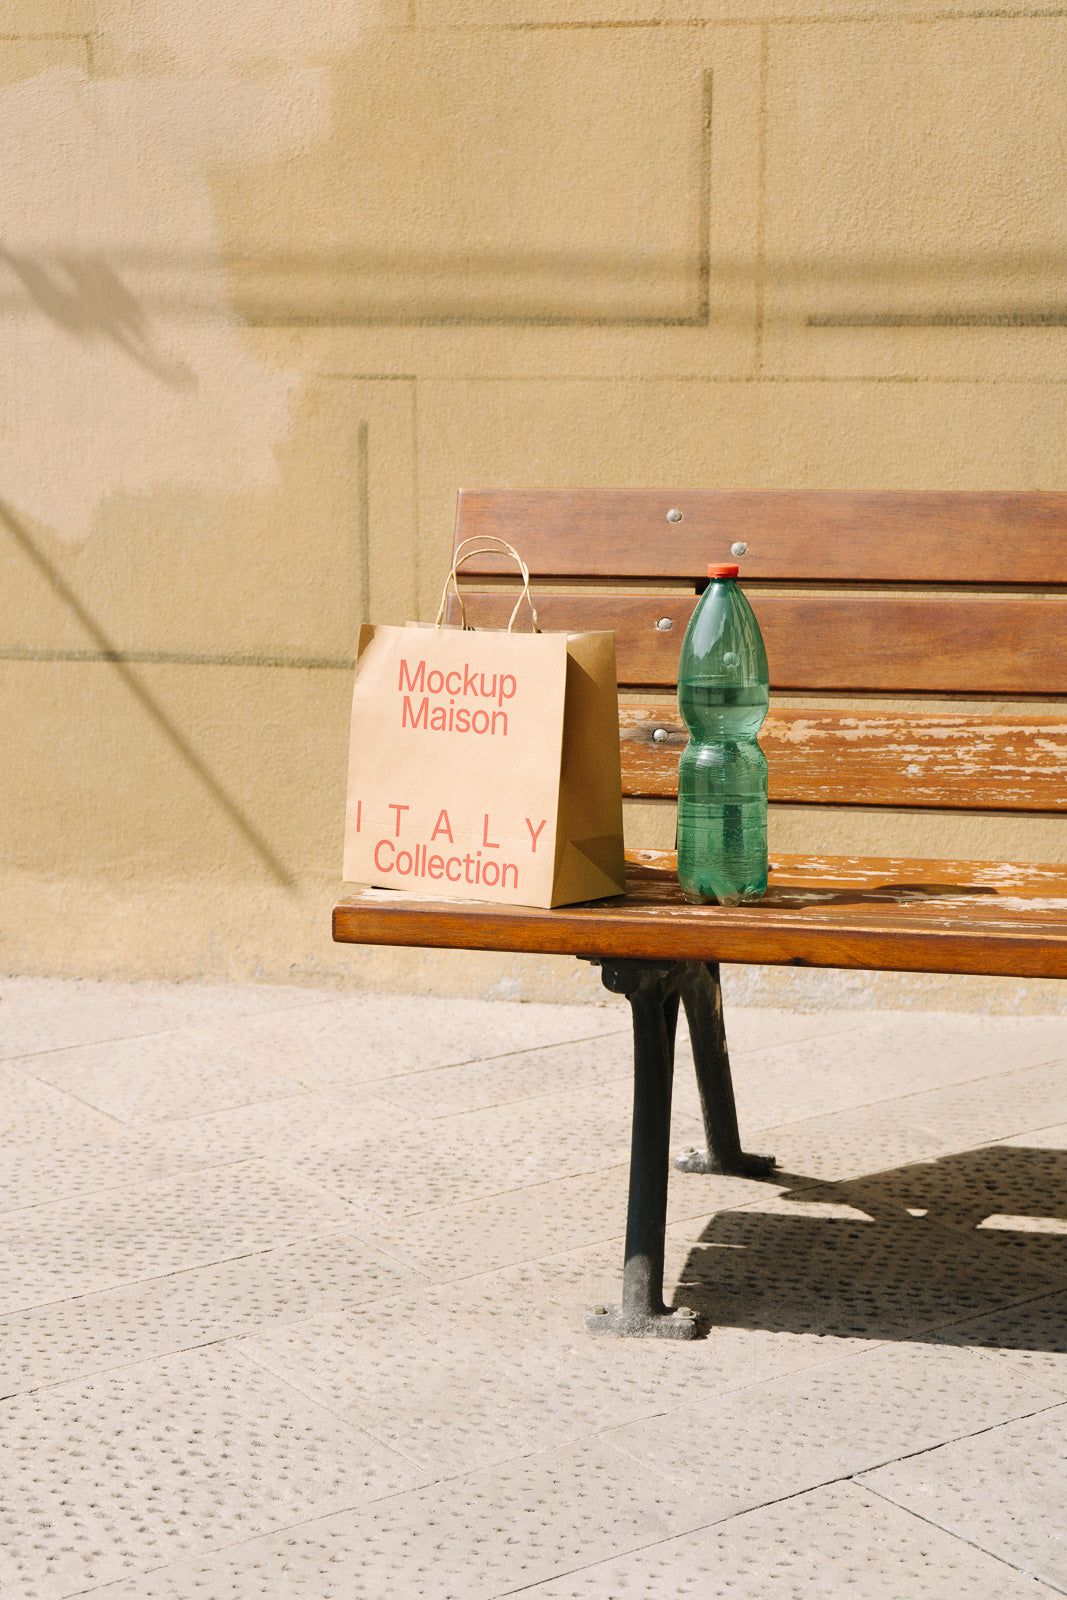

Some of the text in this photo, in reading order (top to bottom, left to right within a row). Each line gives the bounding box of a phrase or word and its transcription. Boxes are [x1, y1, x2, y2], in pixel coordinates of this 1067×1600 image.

[398, 659, 517, 708] Mockup
[401, 695, 508, 736] Maison
[374, 839, 519, 889] Collection
